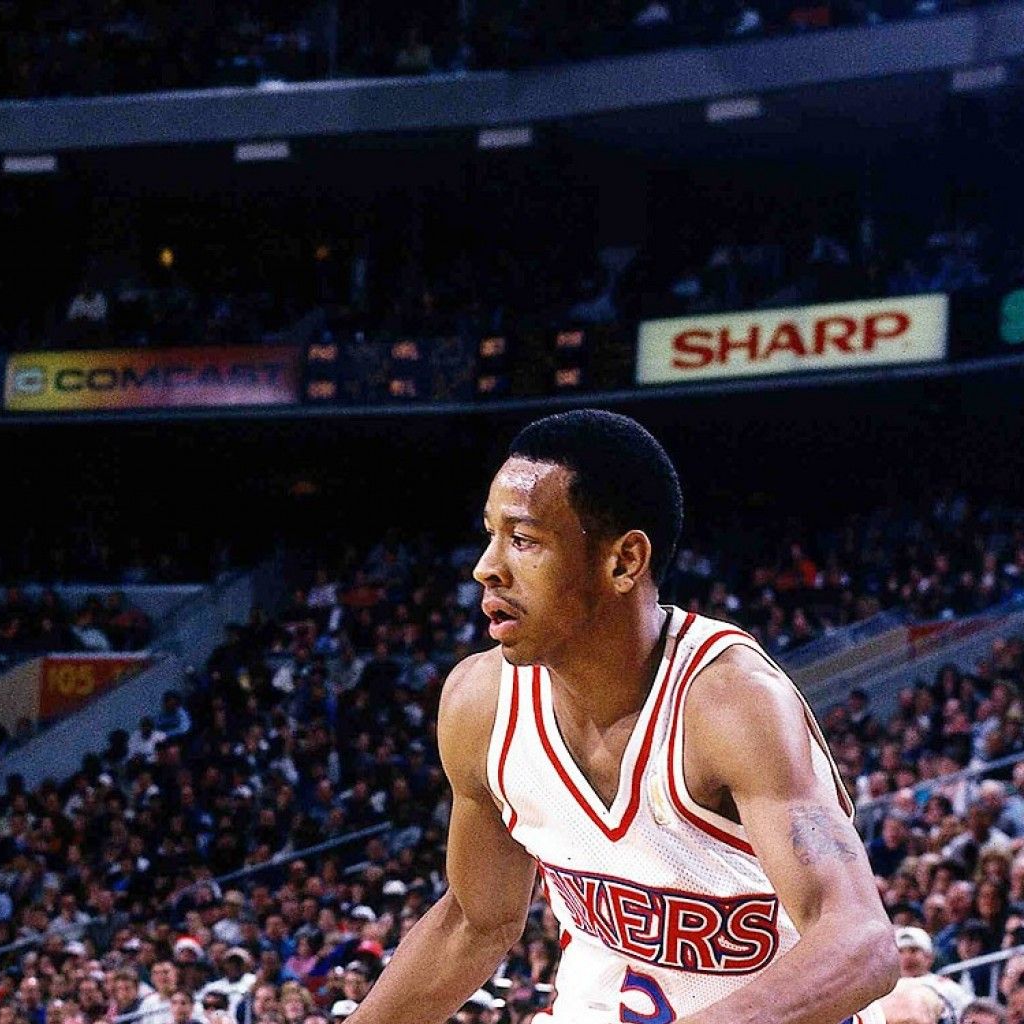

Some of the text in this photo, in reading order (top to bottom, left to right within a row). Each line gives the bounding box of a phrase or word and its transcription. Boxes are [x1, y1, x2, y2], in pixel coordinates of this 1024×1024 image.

[671, 310, 911, 370] SHARP
[54, 363, 284, 392] COMCAST
[542, 866, 779, 972] XERS
